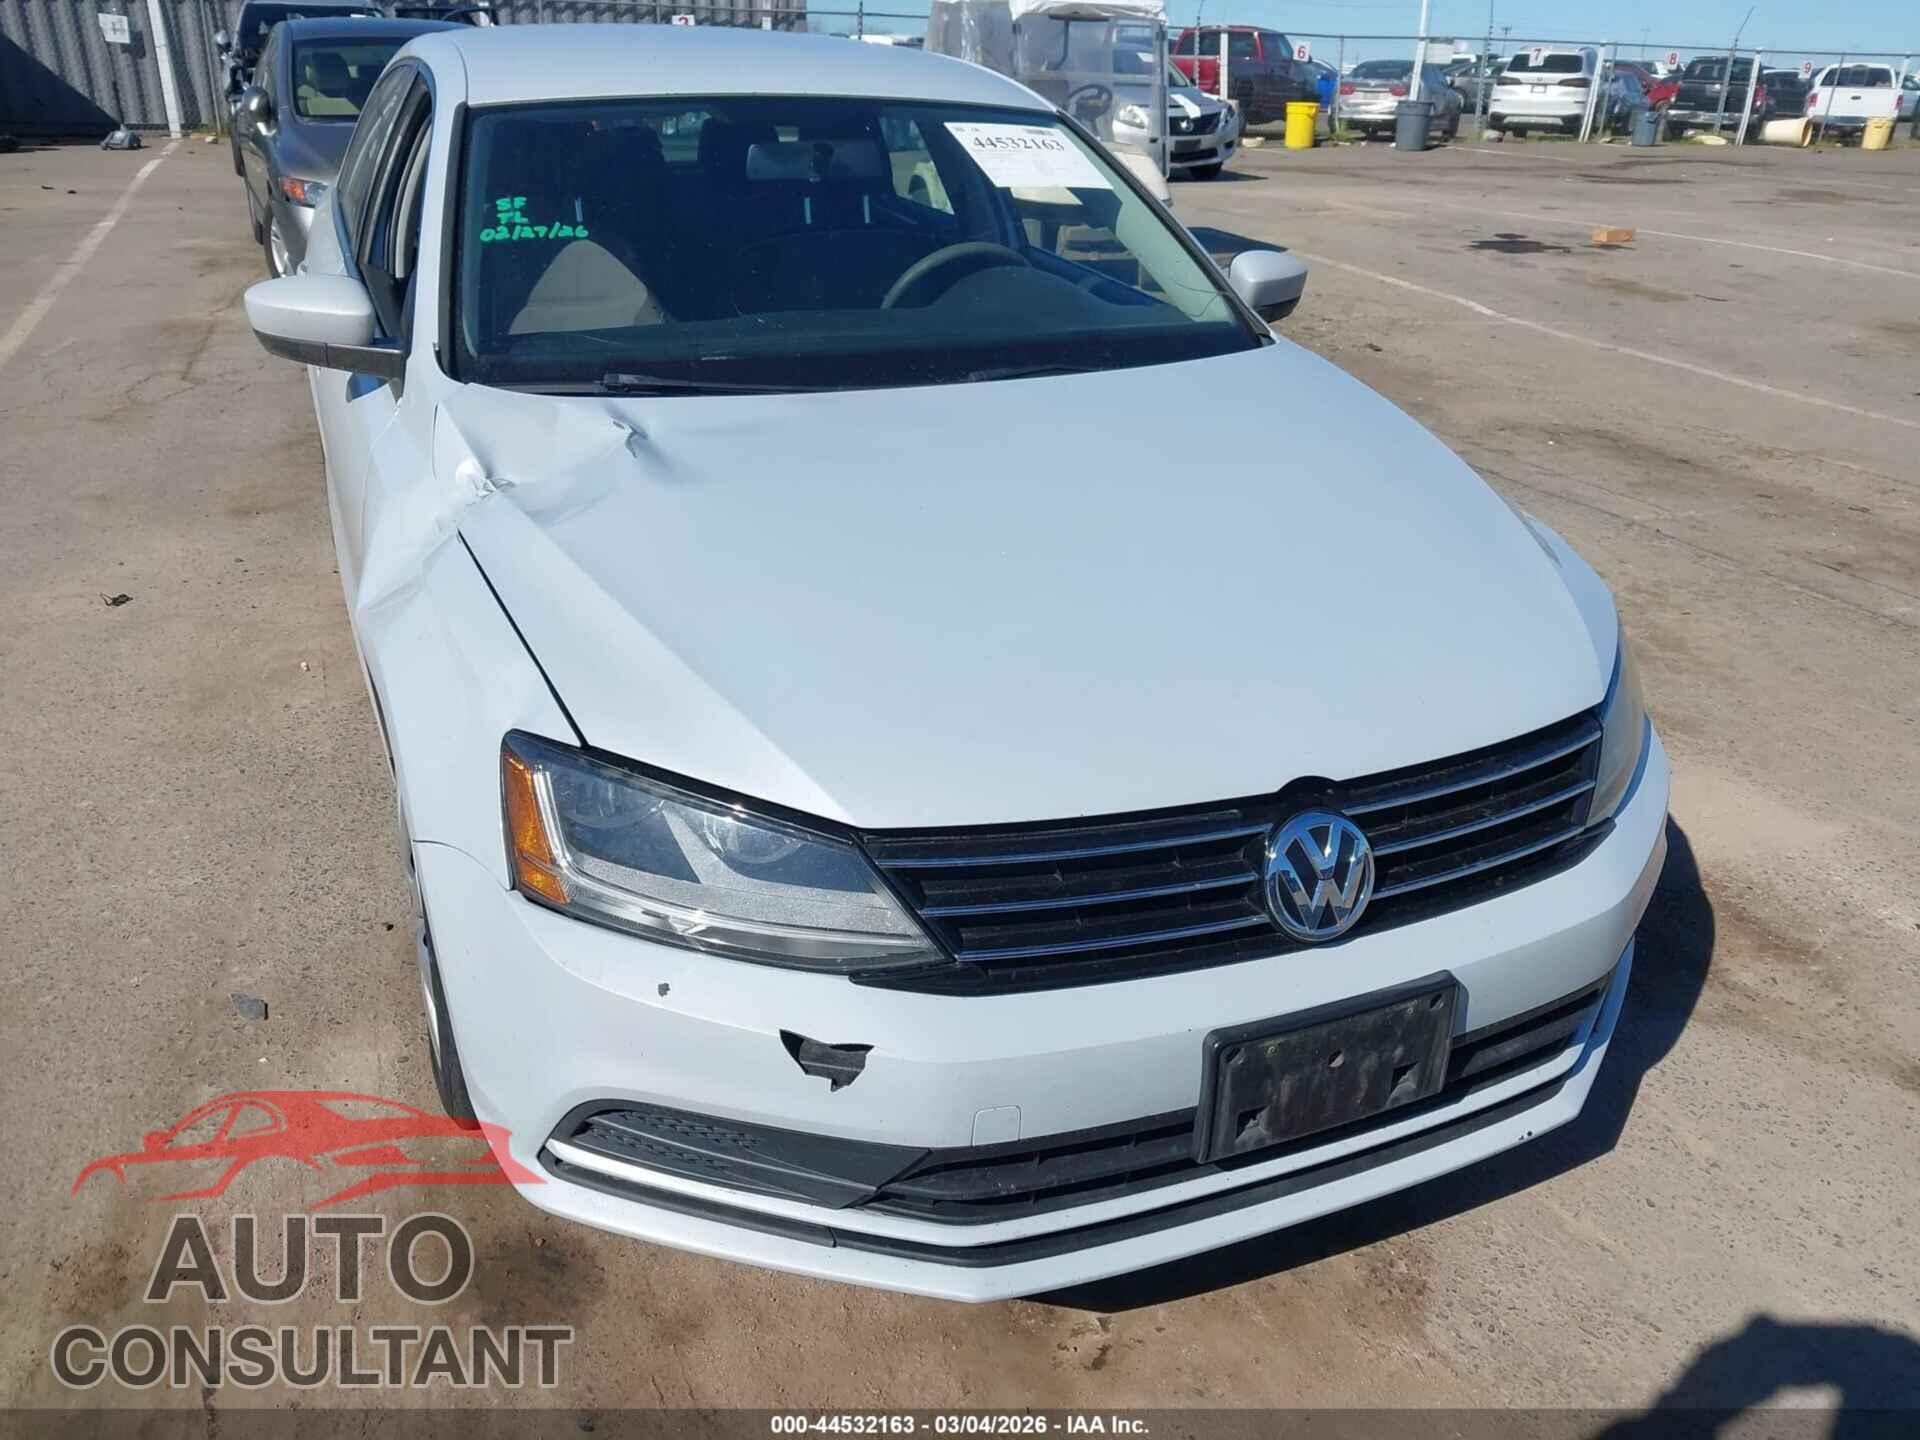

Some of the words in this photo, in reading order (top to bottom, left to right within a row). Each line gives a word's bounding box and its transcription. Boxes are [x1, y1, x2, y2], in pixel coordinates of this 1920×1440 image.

[1297, 45, 1306, 59] 6
[972, 136, 1065, 151] 44532163
[480, 222, 589, 241] 02/27/26
[1265, 811, 1375, 941] VW
